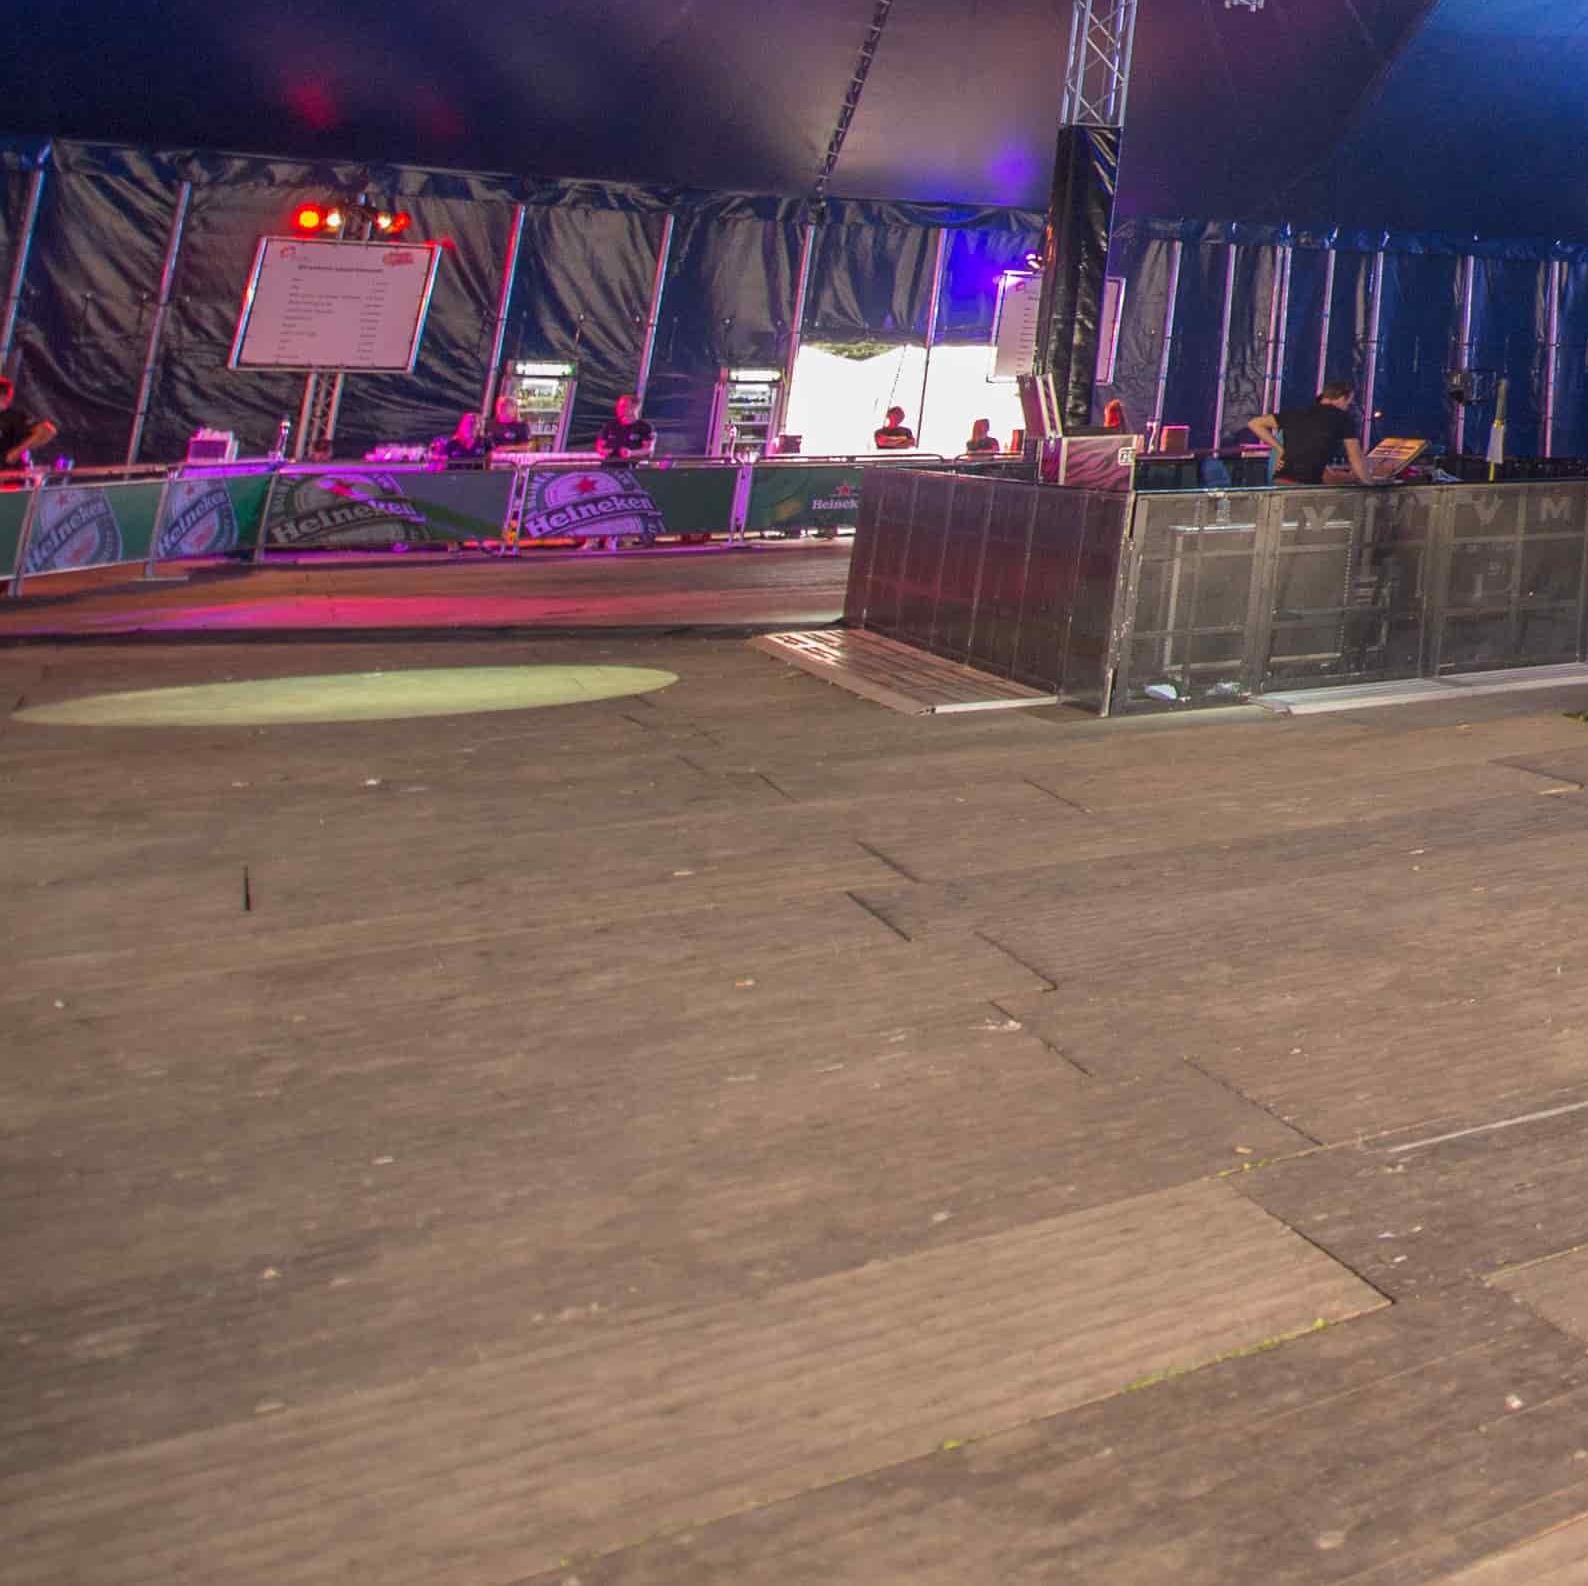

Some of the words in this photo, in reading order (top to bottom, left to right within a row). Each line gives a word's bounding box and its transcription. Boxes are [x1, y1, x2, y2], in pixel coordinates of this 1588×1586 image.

[271, 499, 417, 543] Heineken
[526, 496, 655, 538] Heineken
[811, 498, 859, 511] Heinek
